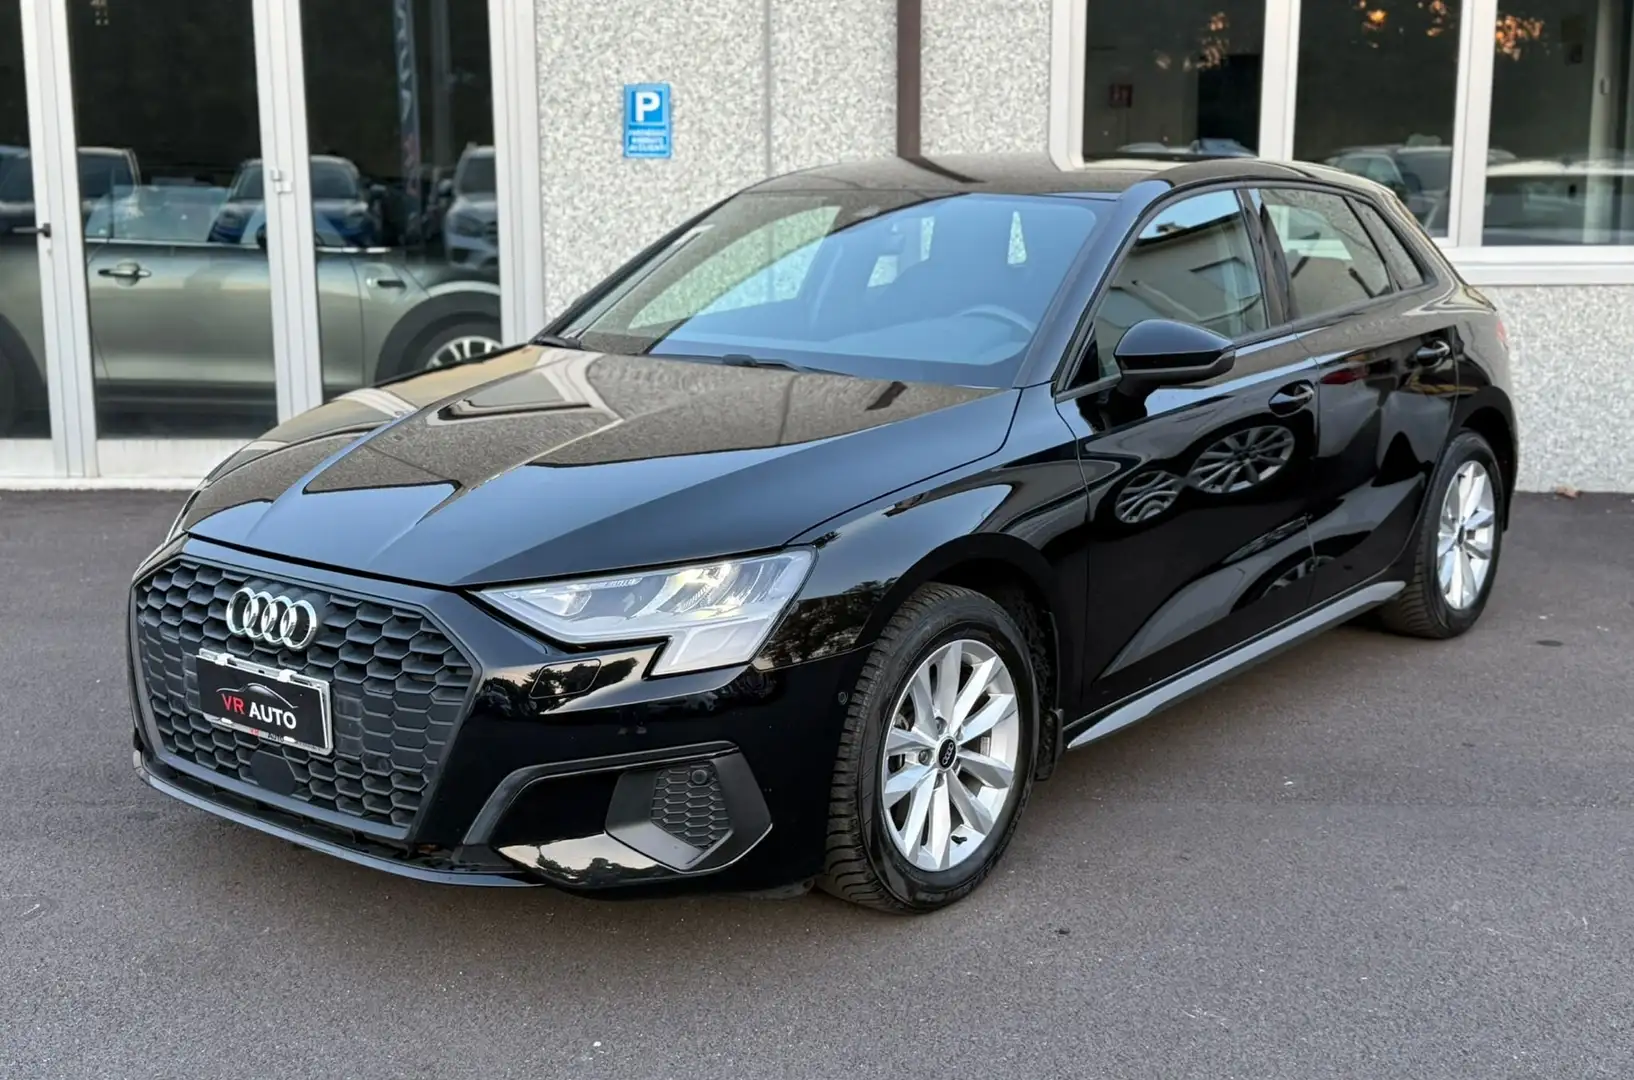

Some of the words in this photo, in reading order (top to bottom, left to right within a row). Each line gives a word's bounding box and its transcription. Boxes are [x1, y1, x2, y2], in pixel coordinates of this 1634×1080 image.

[635, 91, 661, 122] P
[221, 693, 245, 715] VR
[249, 702, 297, 730] AUTO
